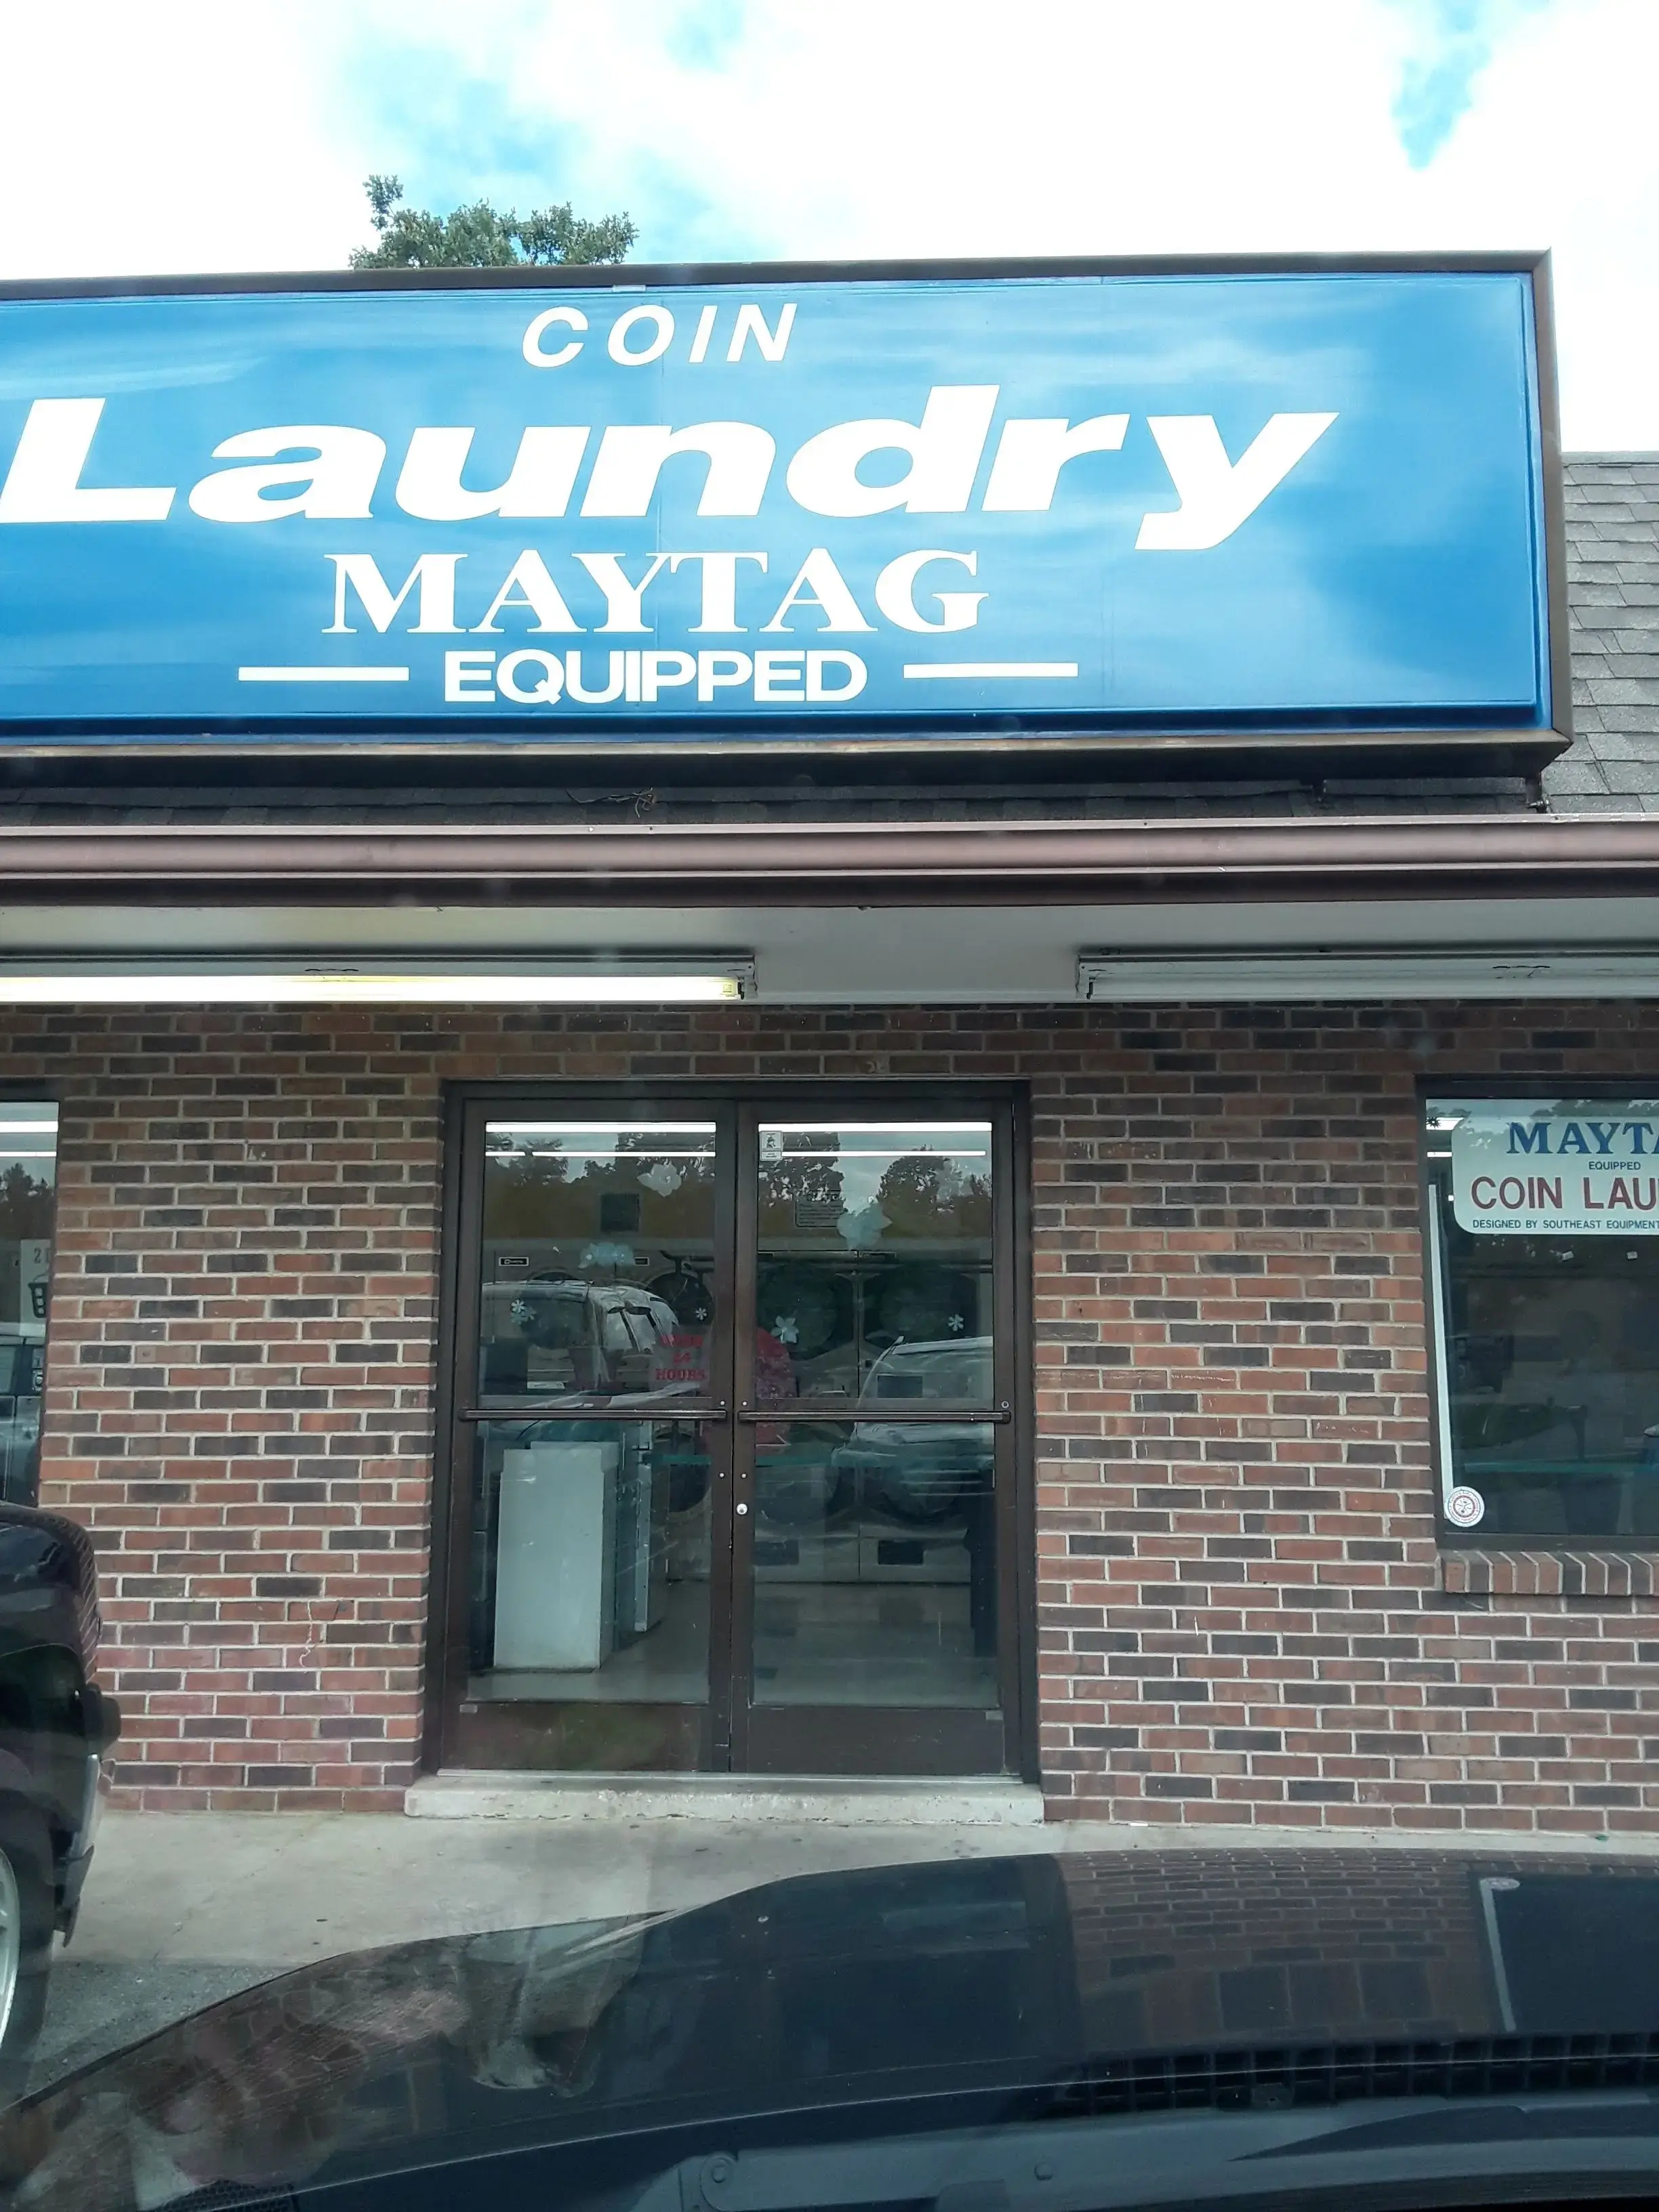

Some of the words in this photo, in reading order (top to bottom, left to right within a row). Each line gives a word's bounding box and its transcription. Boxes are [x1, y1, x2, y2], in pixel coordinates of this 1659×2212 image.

[523, 303, 796, 367] COIN
[0, 384, 1338, 550] Laundry
[321, 548, 989, 634] MAYTAG
[444, 649, 868, 705] EQUIPPED
[1506, 1122, 1659, 1155] MAYT
[1589, 1161, 1641, 1171] EQUIPPED
[1471, 1176, 1563, 1210] COIN
[1582, 1176, 1659, 1211] LAU
[1473, 1219, 1521, 1229] DESIGNED
[1526, 1219, 1538, 1229] BY
[1543, 1220, 1601, 1229] SOUTHEAST
[655, 1368, 707, 1381] HOURS
